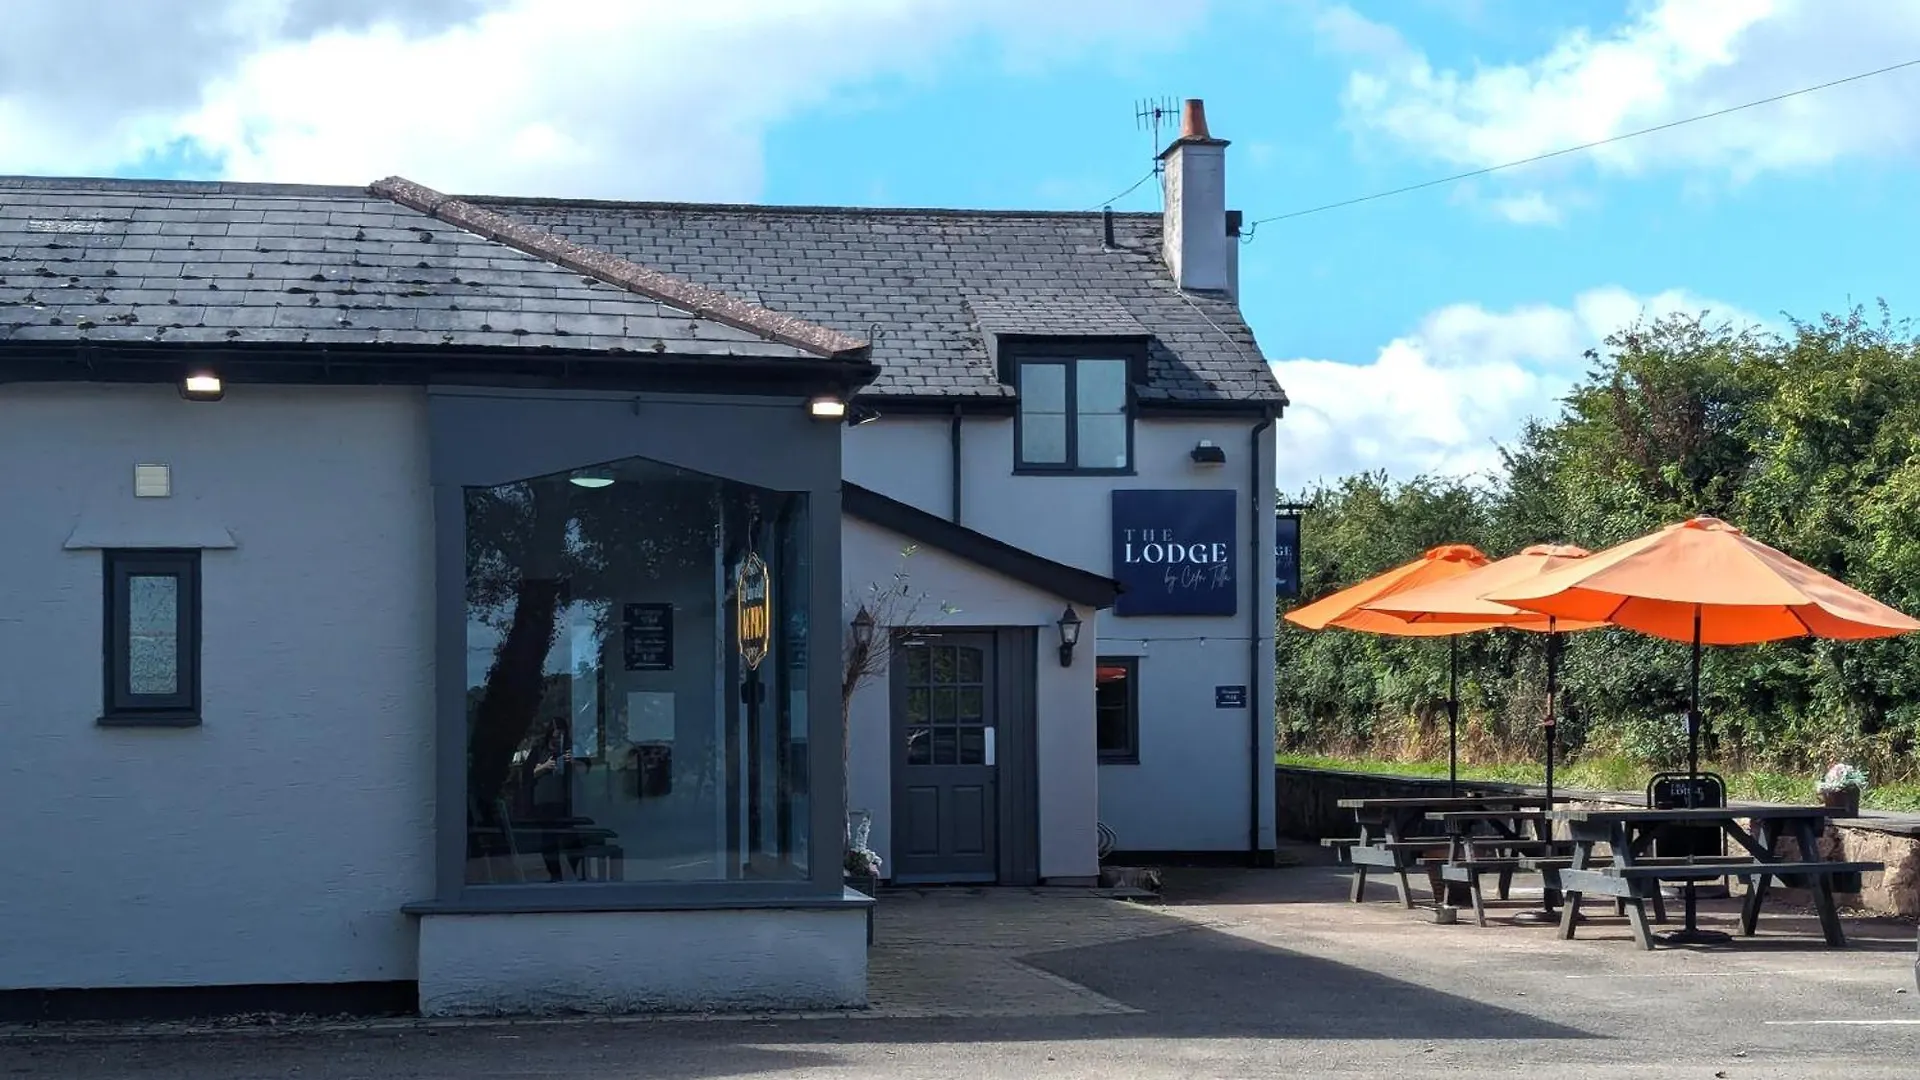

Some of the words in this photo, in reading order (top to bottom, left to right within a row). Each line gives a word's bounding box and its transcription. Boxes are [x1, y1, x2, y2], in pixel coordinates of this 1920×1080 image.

[1124, 529, 1173, 541] THE
[1125, 543, 1227, 563] LODGE
[1164, 566, 1178, 594] by
